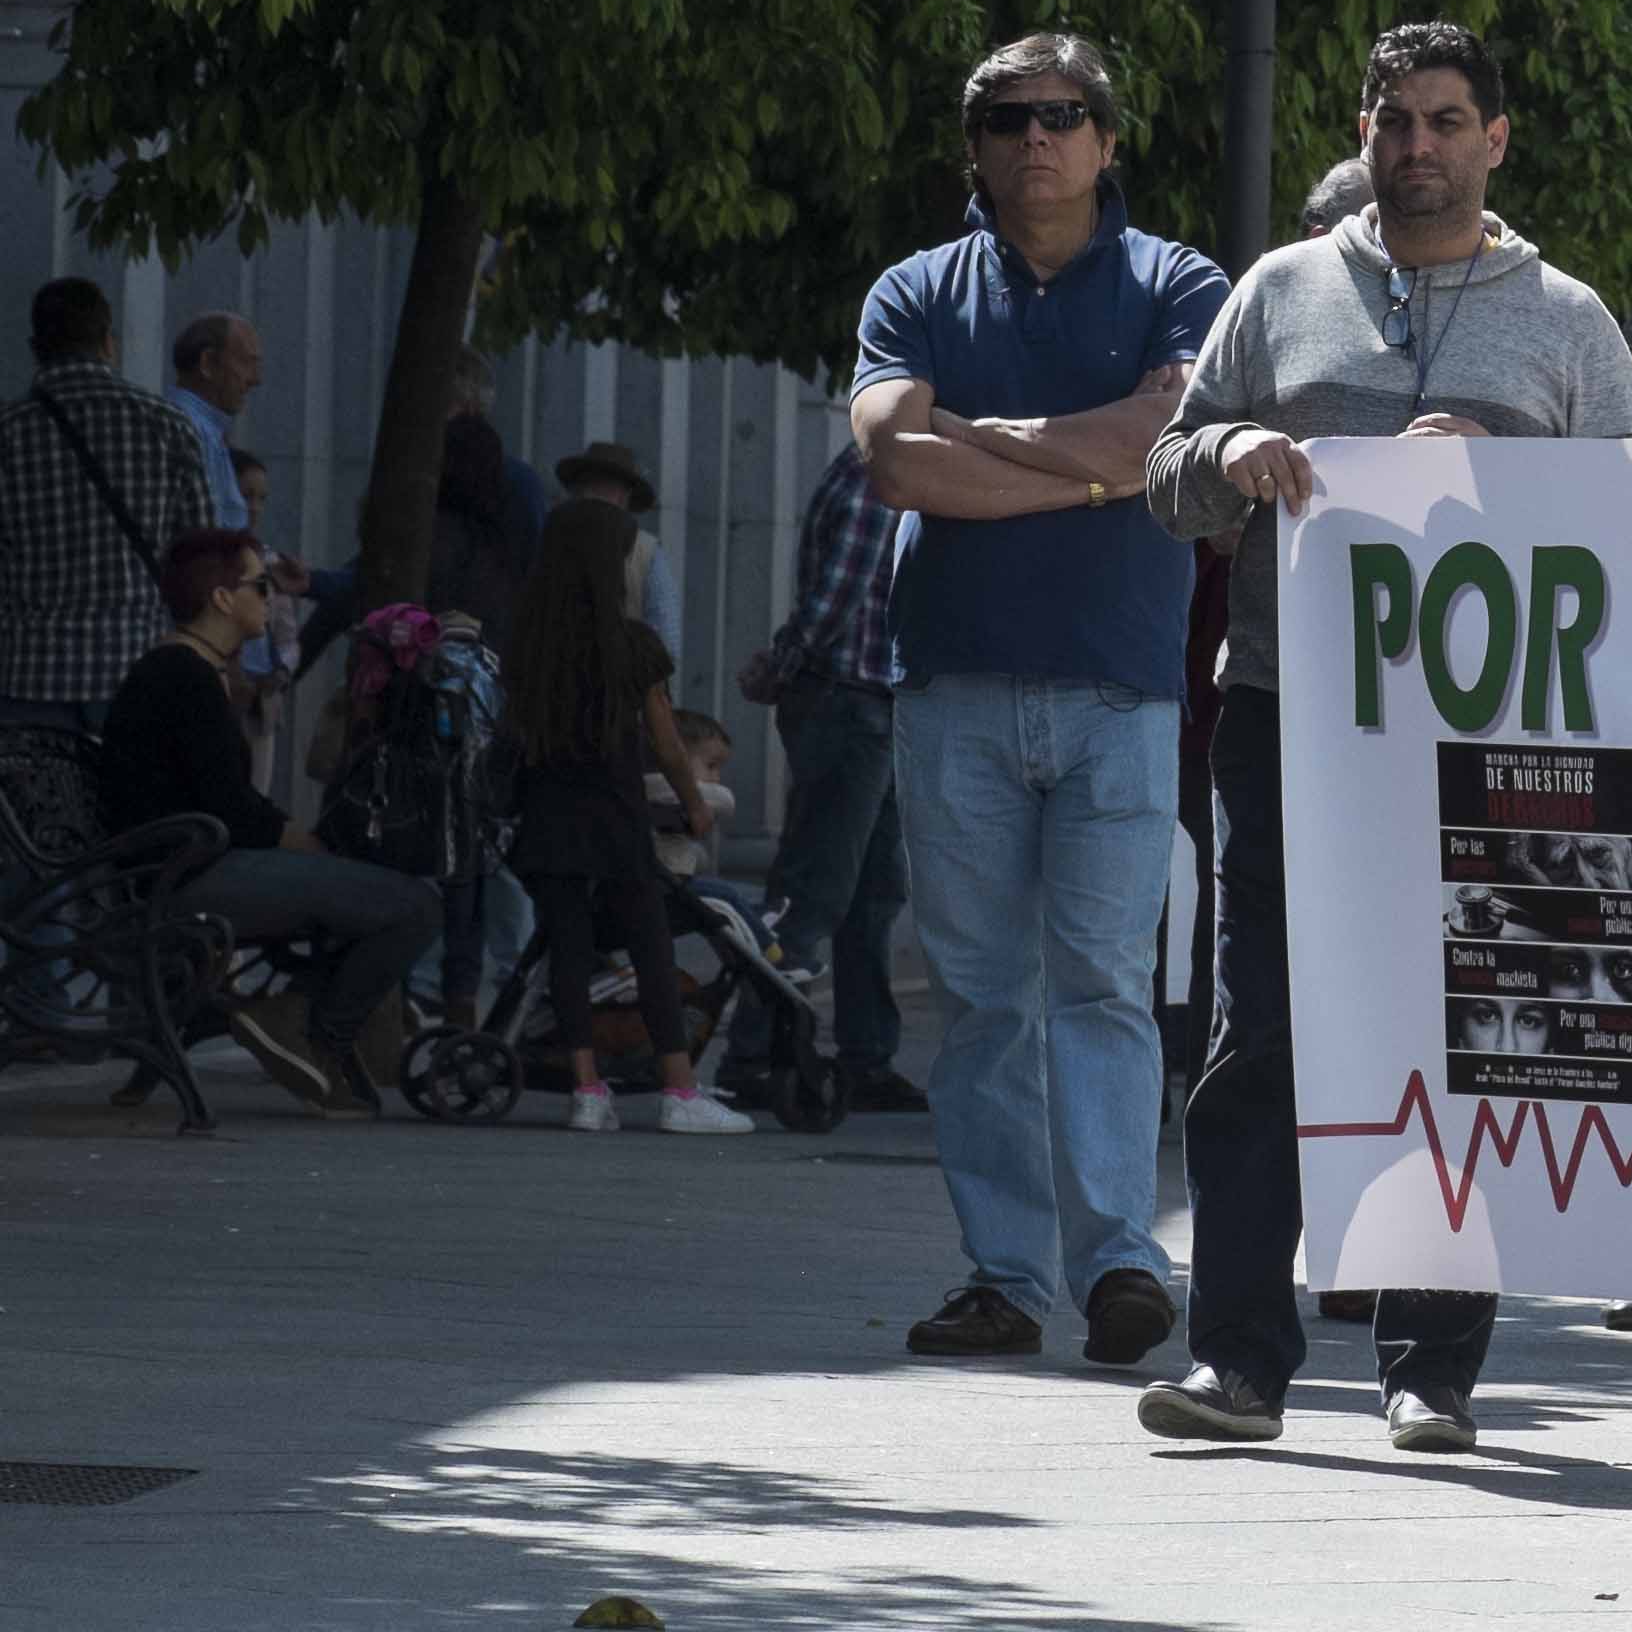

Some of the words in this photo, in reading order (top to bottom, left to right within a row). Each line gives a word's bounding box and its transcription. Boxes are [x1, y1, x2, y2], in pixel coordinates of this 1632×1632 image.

[1353, 544, 1603, 731] POR
[1485, 753, 1519, 767] MARCHA
[1522, 755, 1538, 768] POR
[1541, 755, 1552, 769] LA
[1555, 756, 1595, 770] DIGNIDAD
[1486, 767, 1504, 790] DE
[1513, 768, 1594, 795] NUESTROS
[1450, 836, 1468, 855] Por
[1470, 838, 1486, 856] las
[1600, 896, 1616, 914] Por
[1452, 946, 1485, 968] Contra
[1486, 948, 1496, 968] la
[1496, 969, 1538, 989] machista
[1560, 1008, 1577, 1028] Por
[1579, 1013, 1596, 1029] una
